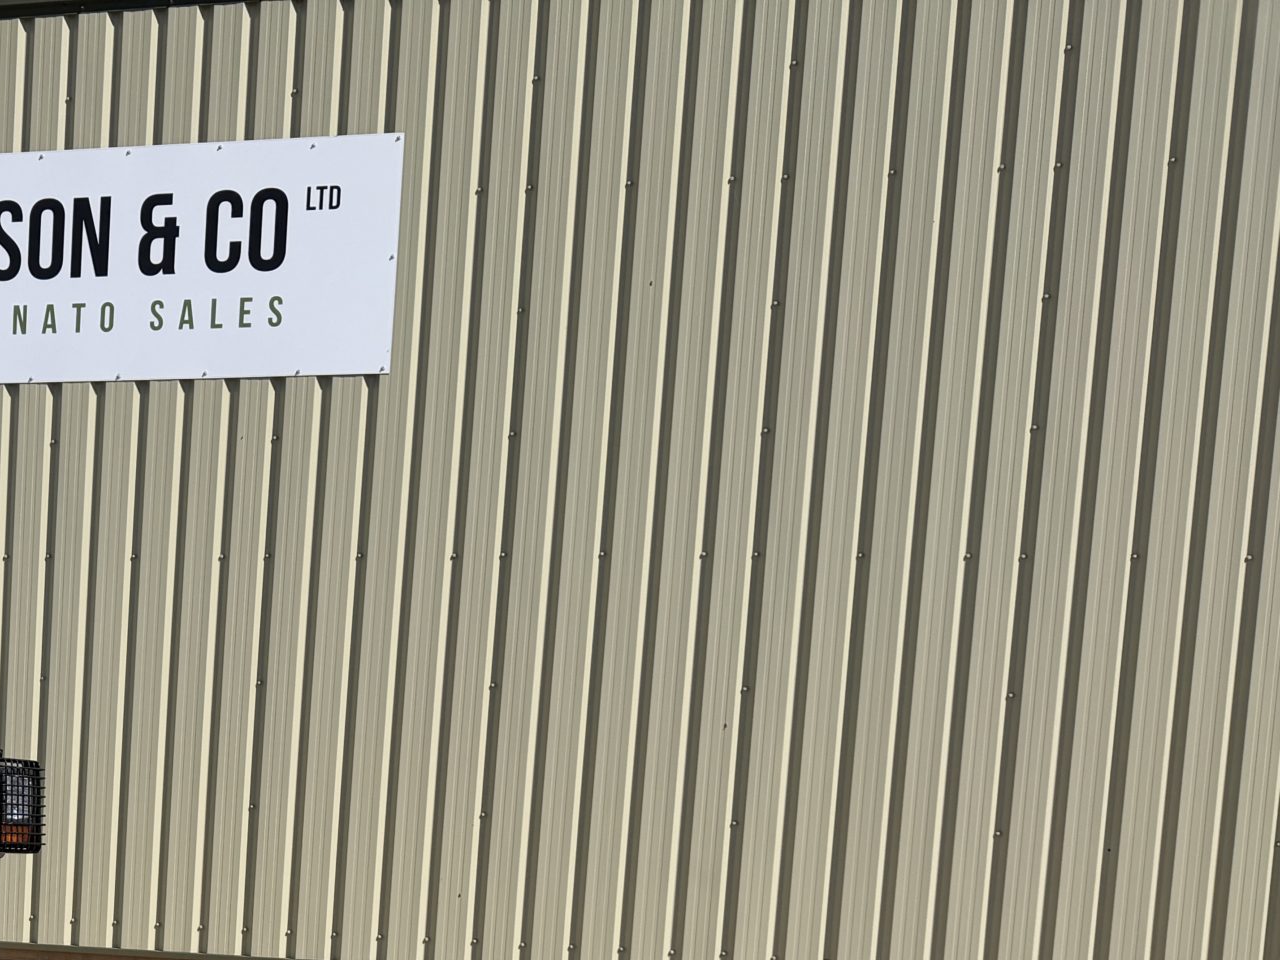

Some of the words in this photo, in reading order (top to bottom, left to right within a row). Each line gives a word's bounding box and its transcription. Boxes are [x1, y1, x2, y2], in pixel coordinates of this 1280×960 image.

[137, 194, 180, 276] &
[204, 188, 289, 274] CO
[306, 186, 342, 211] LTD
[12, 302, 115, 335] NATO
[149, 296, 284, 331] SALES
